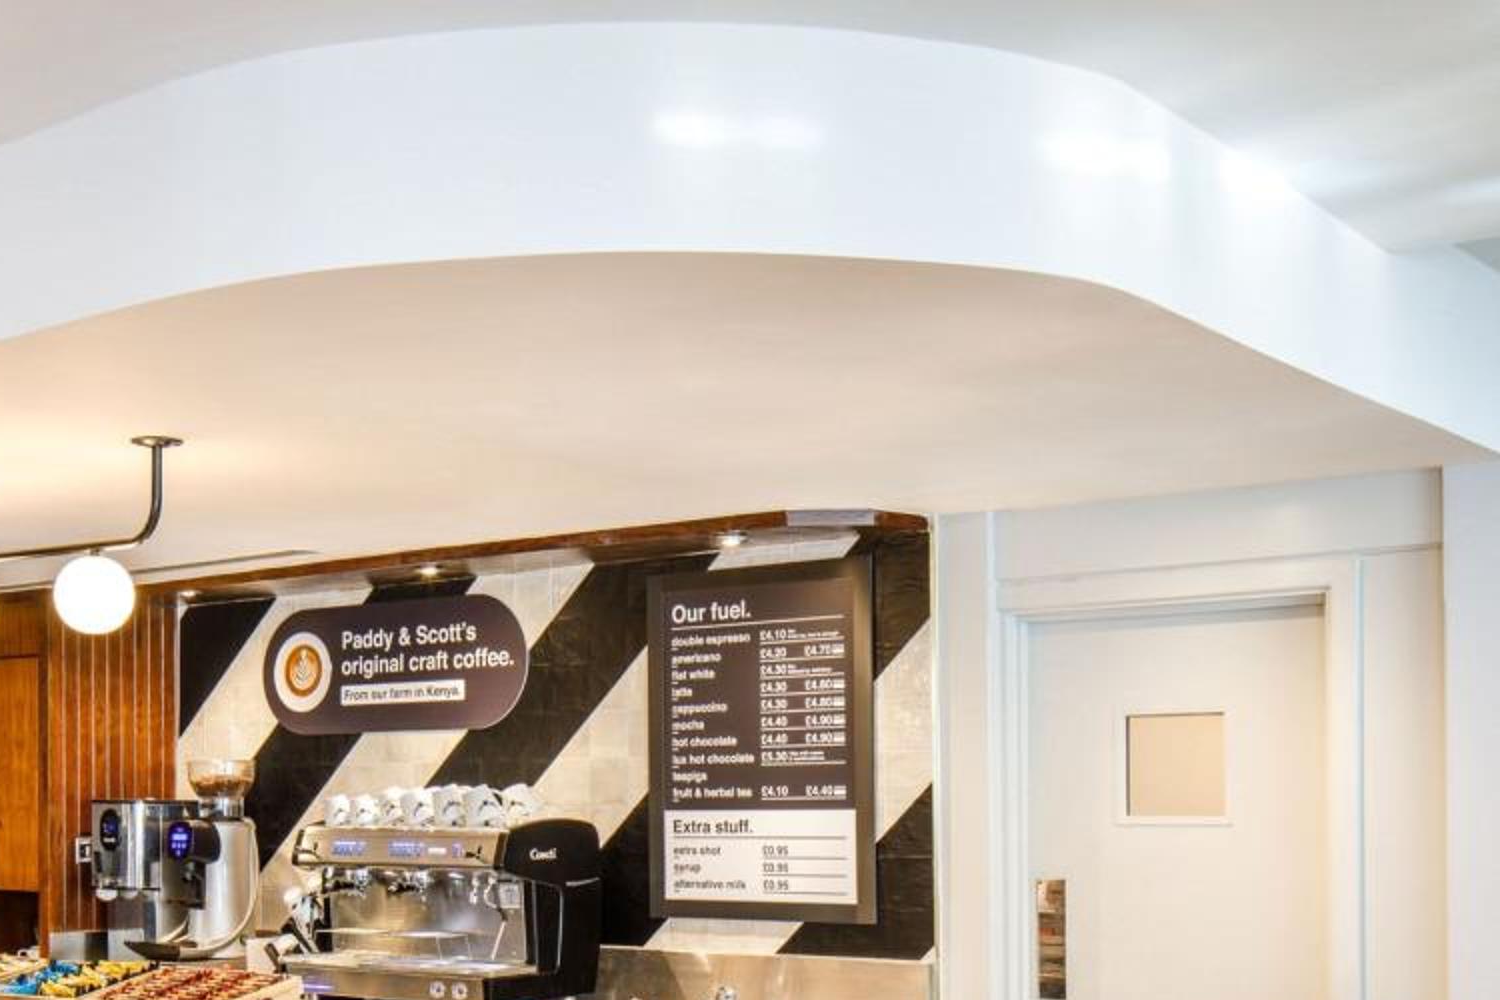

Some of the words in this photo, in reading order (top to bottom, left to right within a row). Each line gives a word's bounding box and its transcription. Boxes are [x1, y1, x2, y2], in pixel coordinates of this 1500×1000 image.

[672, 604, 706, 624] Our
[710, 600, 751, 620] fuel.
[342, 628, 393, 652] Paddy
[399, 627, 411, 645] &
[416, 622, 476, 644] Scott's
[672, 634, 704, 646] double
[342, 654, 404, 678] original
[409, 652, 448, 672] craft
[453, 648, 515, 670] coffee.
[672, 653, 722, 664] americano
[672, 670, 686, 680] flat
[689, 669, 716, 680] white
[344, 690, 370, 700] From
[372, 690, 386, 700] our
[388, 688, 412, 700] farm
[414, 688, 425, 698] in
[672, 687, 693, 698] latte
[672, 702, 728, 716] cappuccino
[672, 720, 704, 730] mocha
[672, 737, 689, 747] hot
[690, 736, 737, 747] chocolate
[689, 754, 705, 764] hot
[707, 753, 755, 764] chocolate
[673, 786, 692, 798] fruit
[694, 787, 702, 798] &
[704, 786, 734, 798] herbal
[673, 820, 711, 834] Extra
[716, 819, 753, 834] stuff.
[674, 846, 697, 855] extra
[700, 846, 721, 855] shot
[674, 880, 724, 890] alternative
[726, 880, 746, 890] milk
